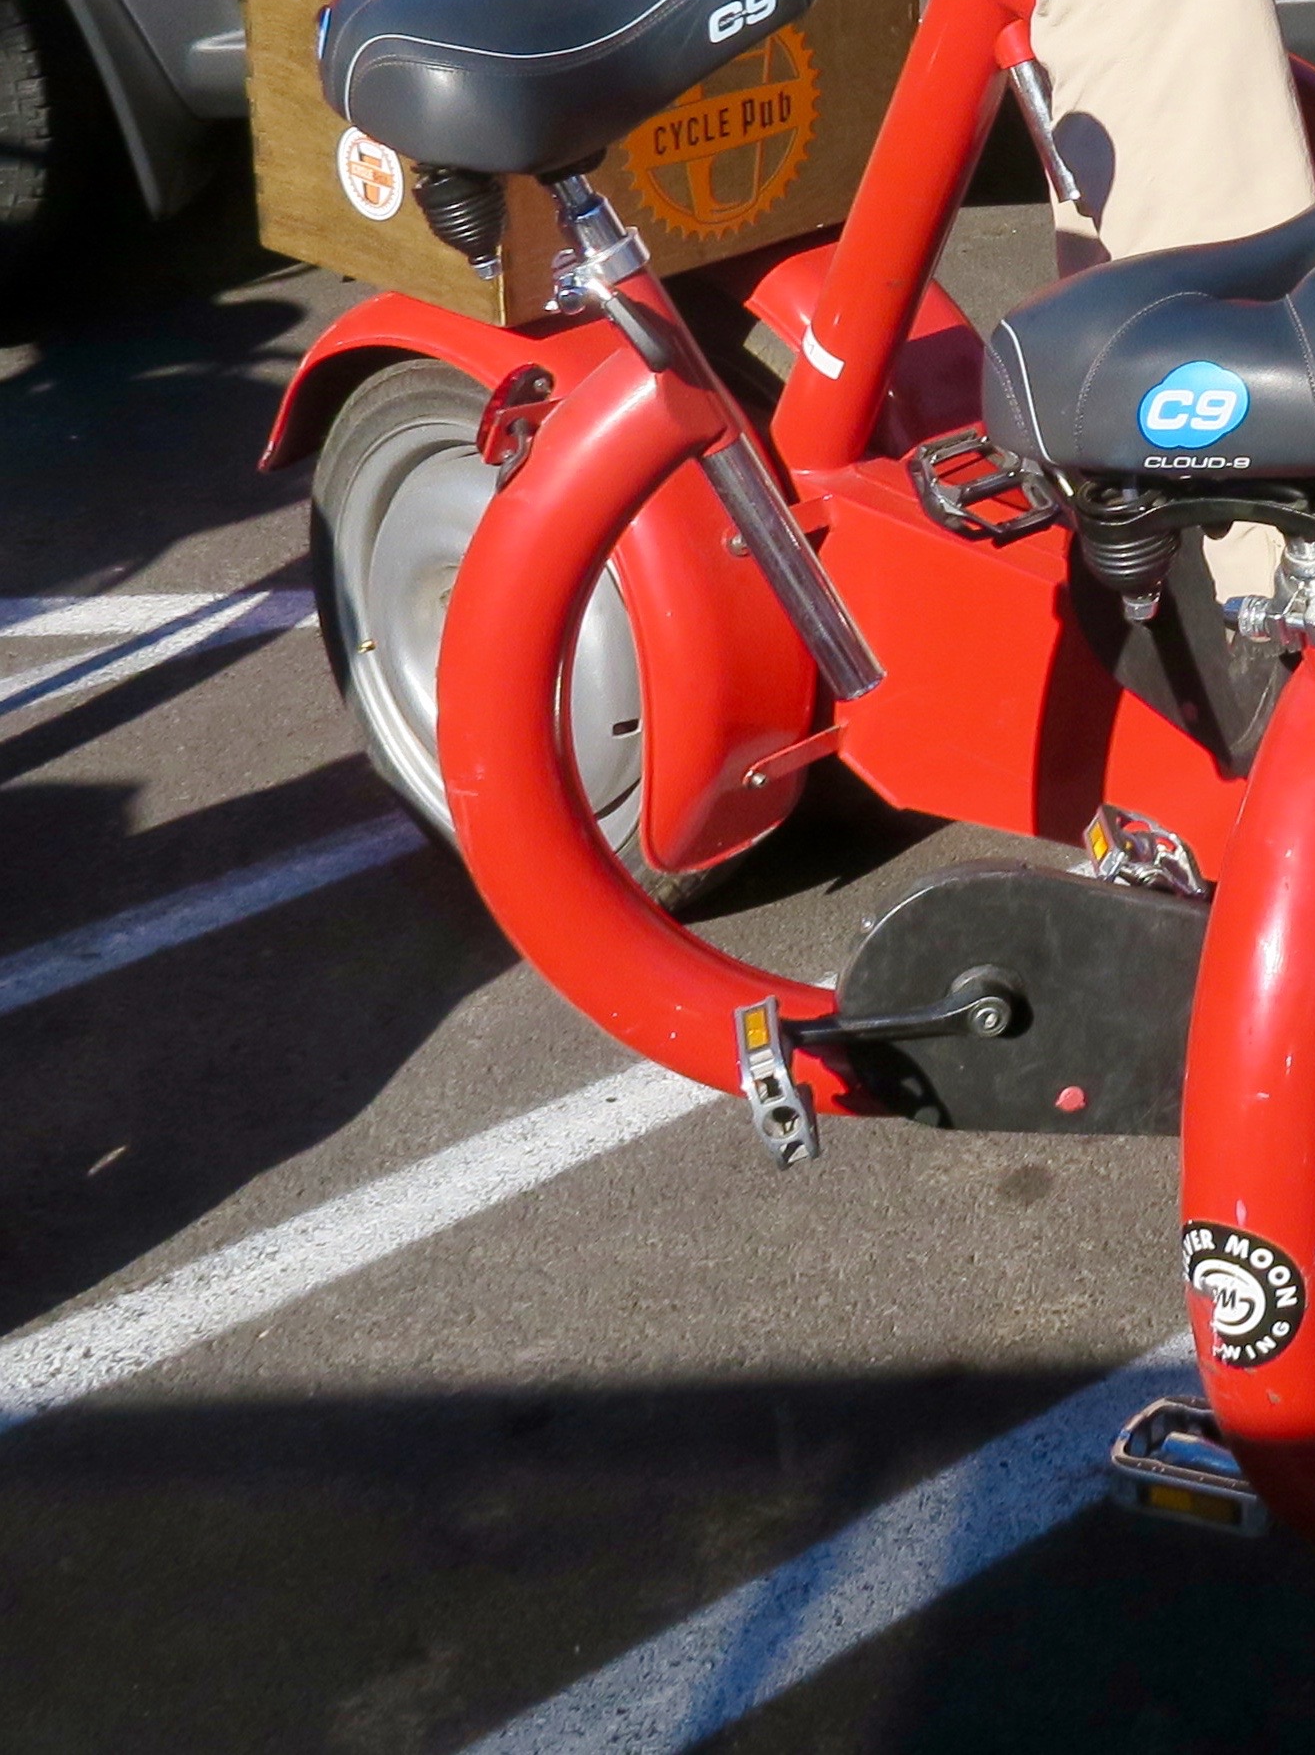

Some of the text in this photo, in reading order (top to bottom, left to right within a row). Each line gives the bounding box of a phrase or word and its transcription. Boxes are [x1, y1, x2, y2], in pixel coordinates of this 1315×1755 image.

[654, 107, 732, 156] CYCLE
[1146, 389, 1238, 431] C9
[1143, 456, 1251, 470] CLOUD-9
[1224, 1233, 1299, 1309] MOON
